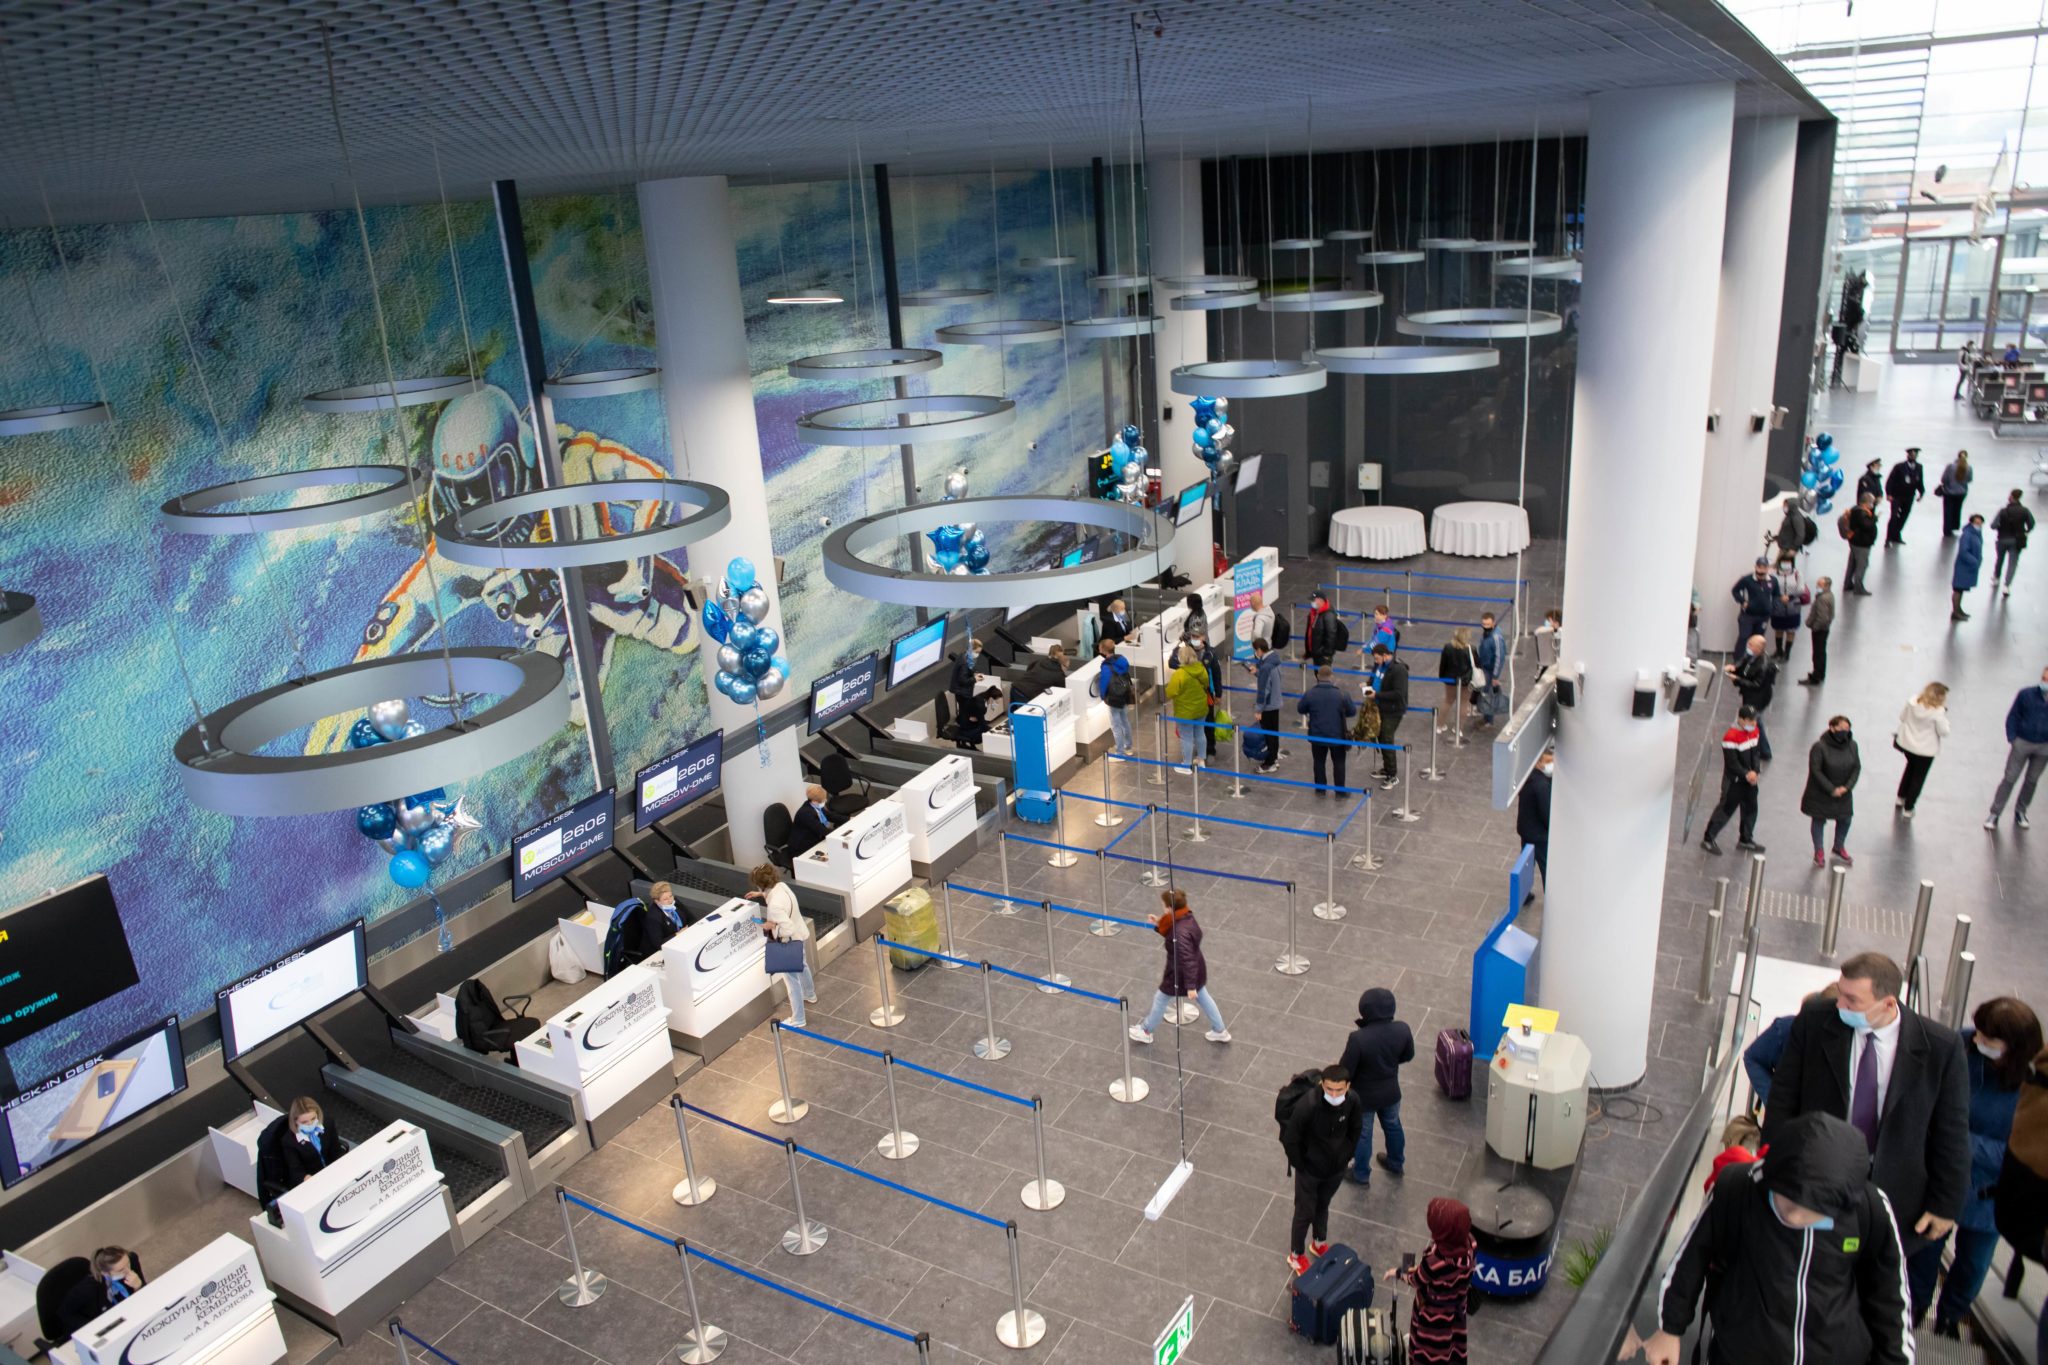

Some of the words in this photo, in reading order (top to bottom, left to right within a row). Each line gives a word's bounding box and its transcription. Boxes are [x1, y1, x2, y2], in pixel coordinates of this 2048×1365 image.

[842, 671, 872, 693] 2606
[638, 757, 670, 778] CHECK-IN
[671, 748, 689, 761] DESK
[678, 754, 715, 781] 2606
[645, 772, 713, 814] MOSCOW-DME
[514, 820, 552, 843] CHECK-IN
[553, 808, 575, 823] DESK
[562, 812, 607, 845] 2606
[524, 831, 605, 881] MOSCOW-DME
[218, 967, 273, 999] CHECK-IN
[276, 948, 307, 970] DESK
[15, 992, 58, 1018] оружия
[167, 1017, 177, 1026] 3
[0, 1076, 61, 1113] HECK-IN
[65, 1054, 104, 1080] DESK
[378, 1153, 421, 1186] АЭРОПОРТ
[380, 1160, 423, 1194] КЕМЕРОВО
[194, 1271, 249, 1314] АЭРОПОРТ
[196, 1279, 252, 1321] КЕМЕРОВО
